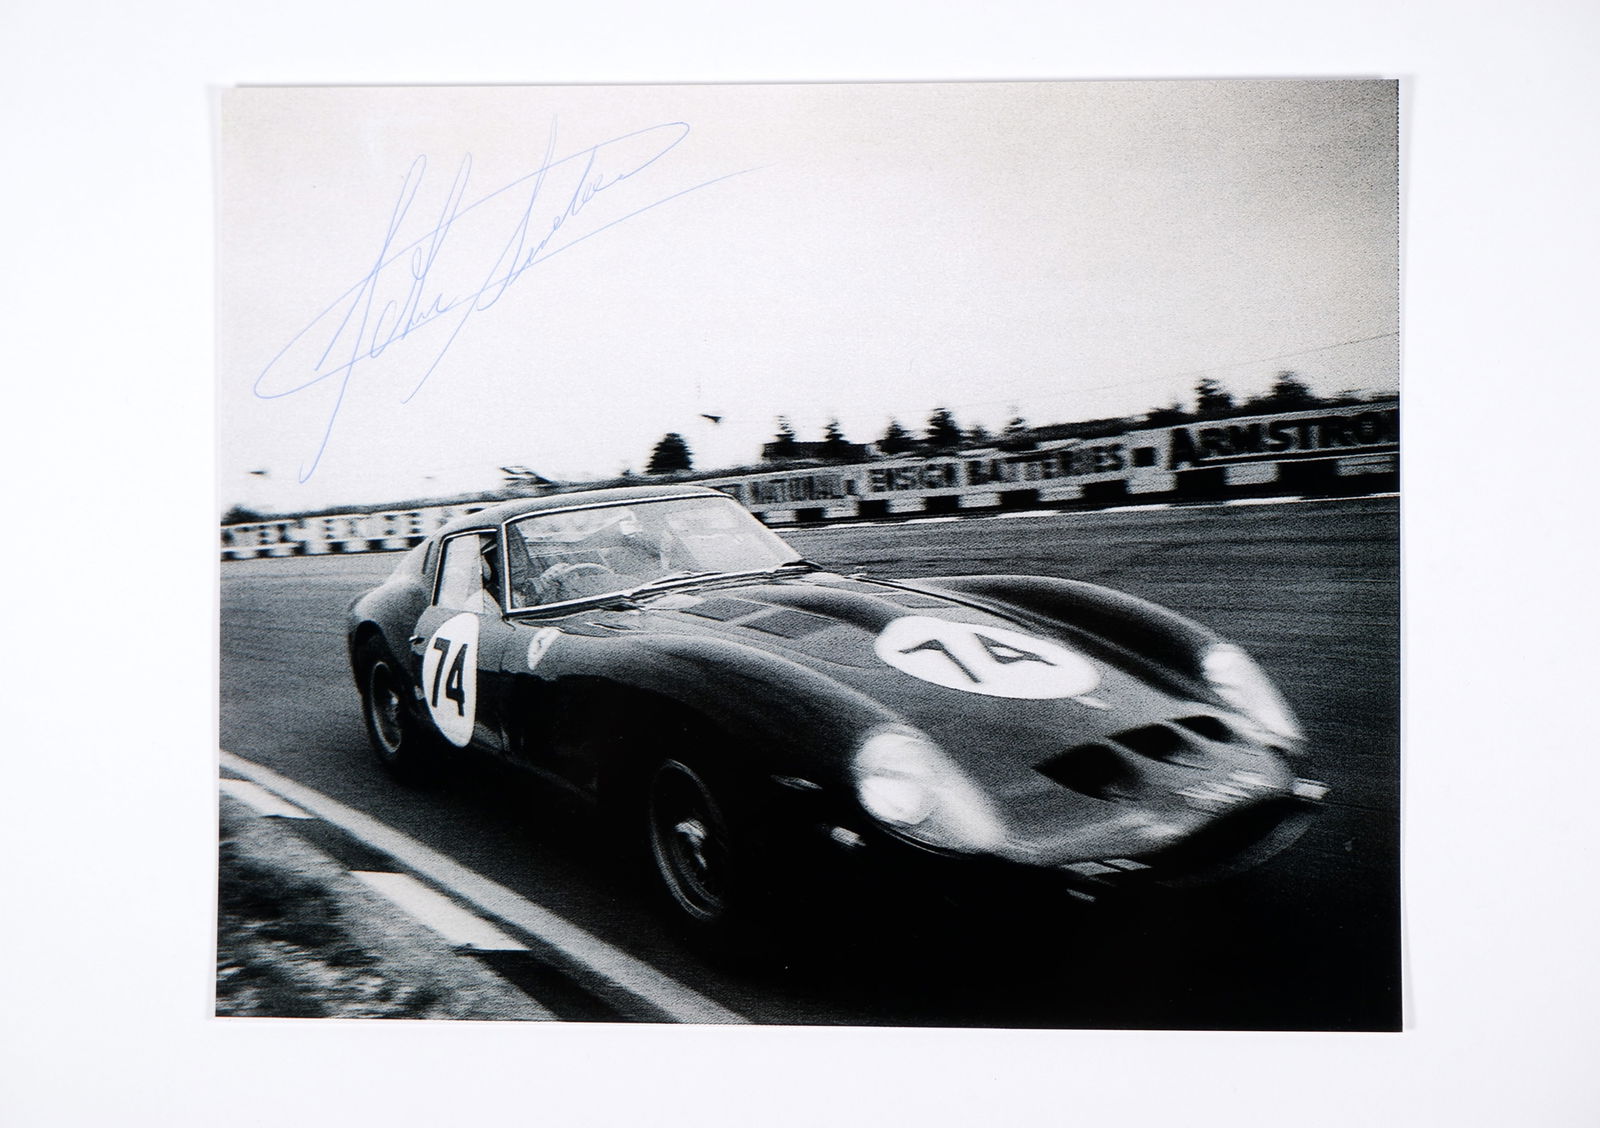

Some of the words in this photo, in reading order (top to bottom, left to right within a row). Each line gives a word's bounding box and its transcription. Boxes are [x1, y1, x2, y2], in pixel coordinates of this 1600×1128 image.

[750, 475, 844, 505] NATIONAL
[868, 459, 957, 492] ENSIGN
[967, 443, 1125, 487] BATTERIES
[431, 636, 469, 717] 74
[898, 632, 1058, 684] 74
